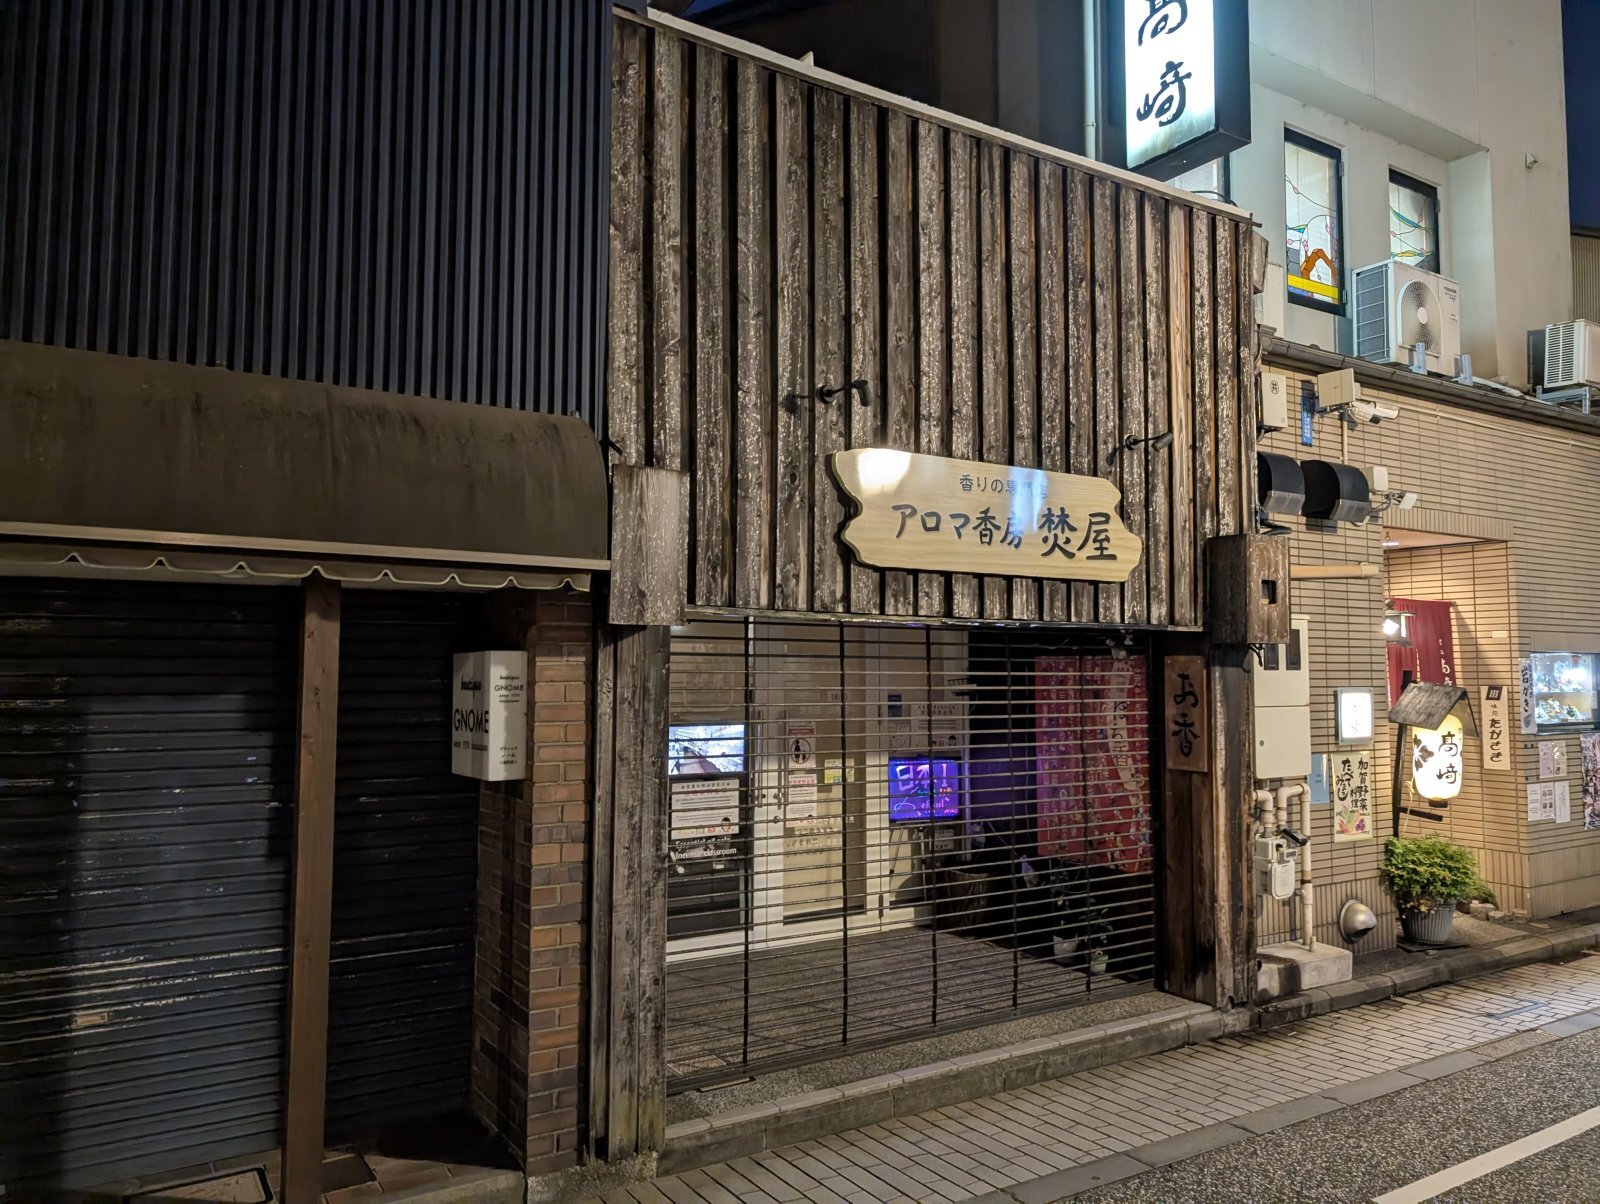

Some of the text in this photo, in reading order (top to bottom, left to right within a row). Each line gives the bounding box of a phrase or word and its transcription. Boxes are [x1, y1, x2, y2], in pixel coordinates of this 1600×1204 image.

[494, 684, 524, 692] GNOME
[454, 708, 489, 734] GNOME
[1172, 673, 1200, 757] お香
[704, 848, 737, 857] classroom
